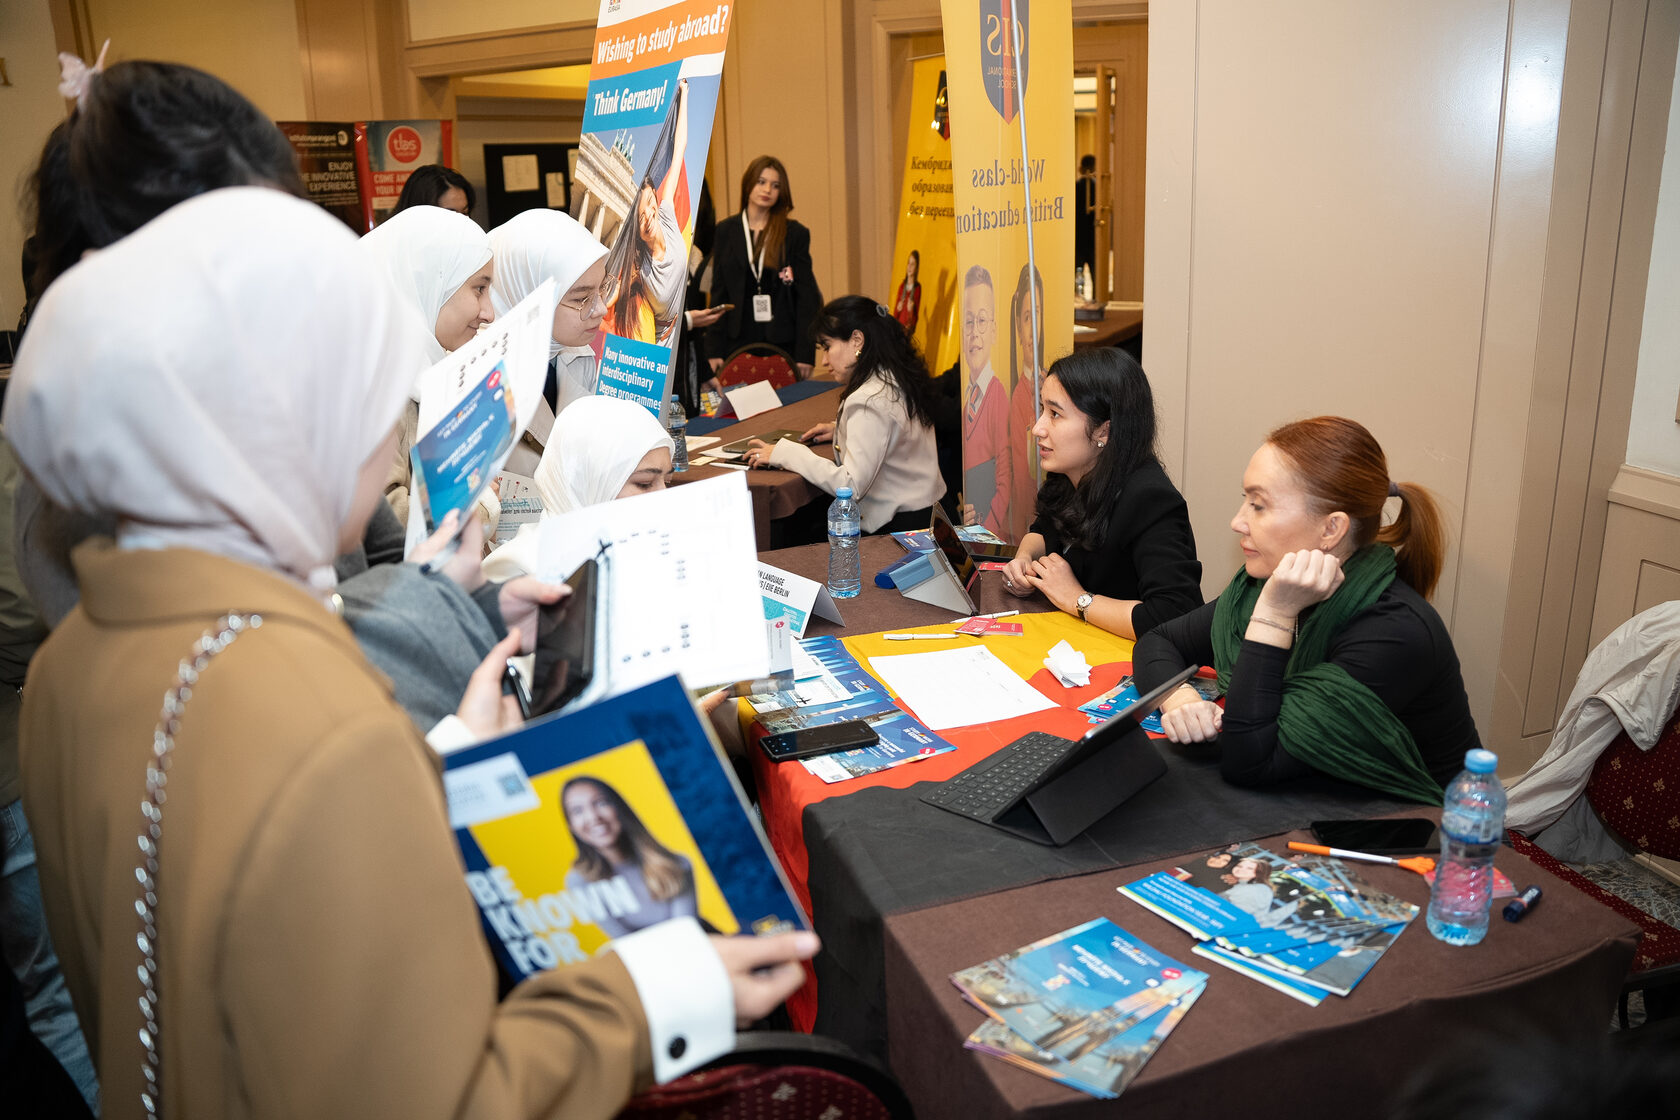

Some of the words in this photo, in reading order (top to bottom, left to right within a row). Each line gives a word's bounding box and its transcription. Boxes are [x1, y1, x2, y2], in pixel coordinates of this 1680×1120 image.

[597, 35, 635, 64] Wishing
[636, 32, 647, 55] to
[647, 20, 677, 53] study
[677, 4, 729, 43] abroad?
[593, 88, 620, 116] Think
[620, 79, 668, 113] Germany!
[328, 161, 353, 171] ENJOY
[309, 180, 357, 192] EXPERIENCE
[604, 346, 618, 364] Many
[618, 350, 656, 371] innovative
[599, 380, 618, 398] Degree
[601, 363, 654, 392] interdisciplinary
[762, 572, 786, 587] LANGUAGE
[774, 585, 791, 598] BERLIN
[465, 865, 523, 906] BE
[484, 873, 642, 941] KNOWN
[503, 929, 588, 976] FOR
